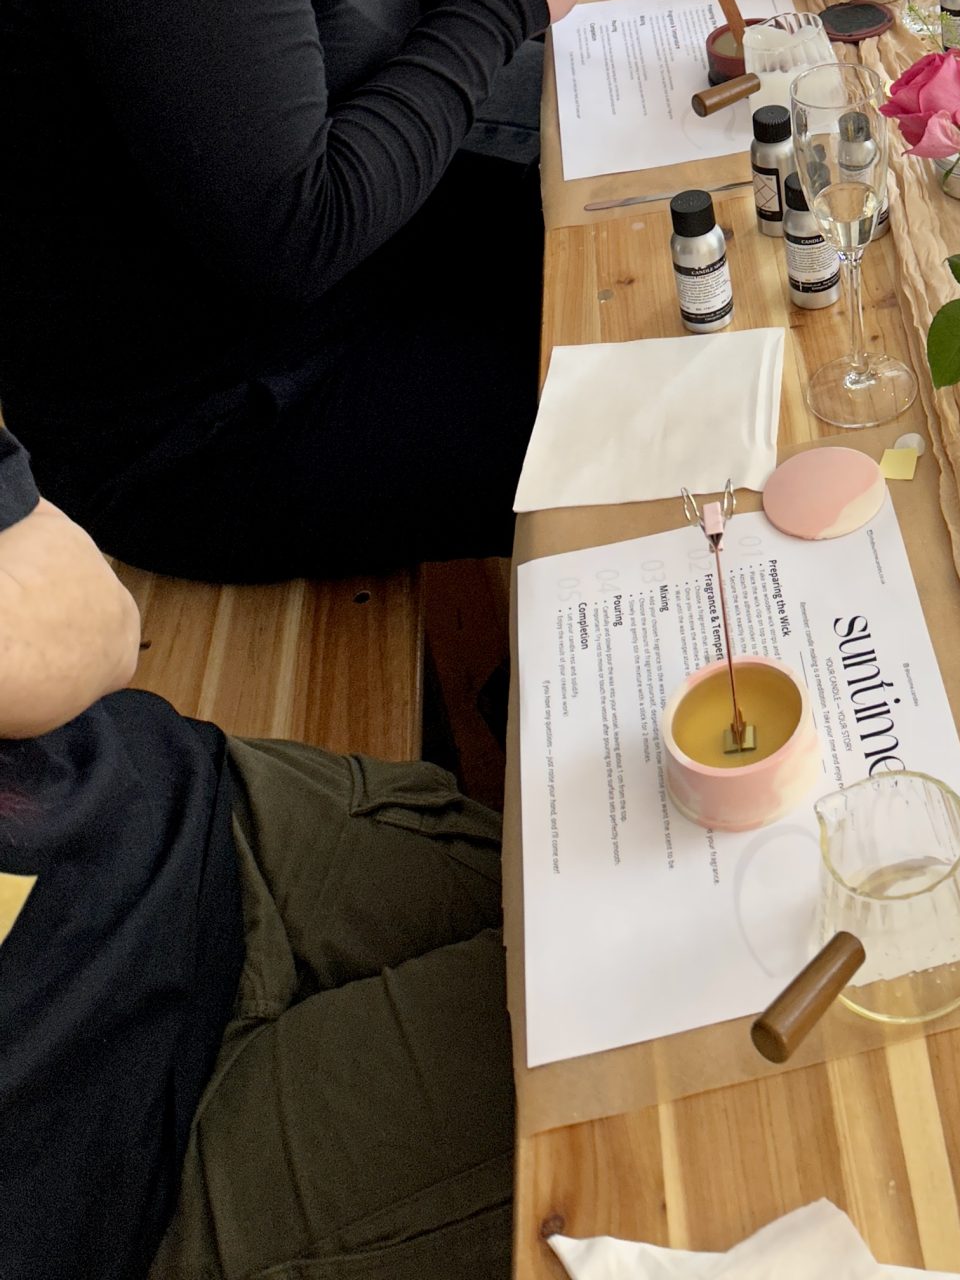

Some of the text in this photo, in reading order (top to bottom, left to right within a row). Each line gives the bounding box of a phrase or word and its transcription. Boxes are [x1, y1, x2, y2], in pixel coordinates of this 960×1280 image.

[800, 237, 825, 245] CANDLE
[659, 584, 669, 612] Mixing
[703, 573, 717, 614] Fragrance
[768, 559, 792, 637] Preparing the Wick
[612, 594, 623, 627] Pouring
[577, 602, 589, 650] Completion
[826, 657, 836, 675] YOUR
[829, 676, 841, 701] CANDLE
[833, 615, 905, 779] suntime
[838, 710, 848, 730] YOUR
[841, 730, 852, 752] STORY
